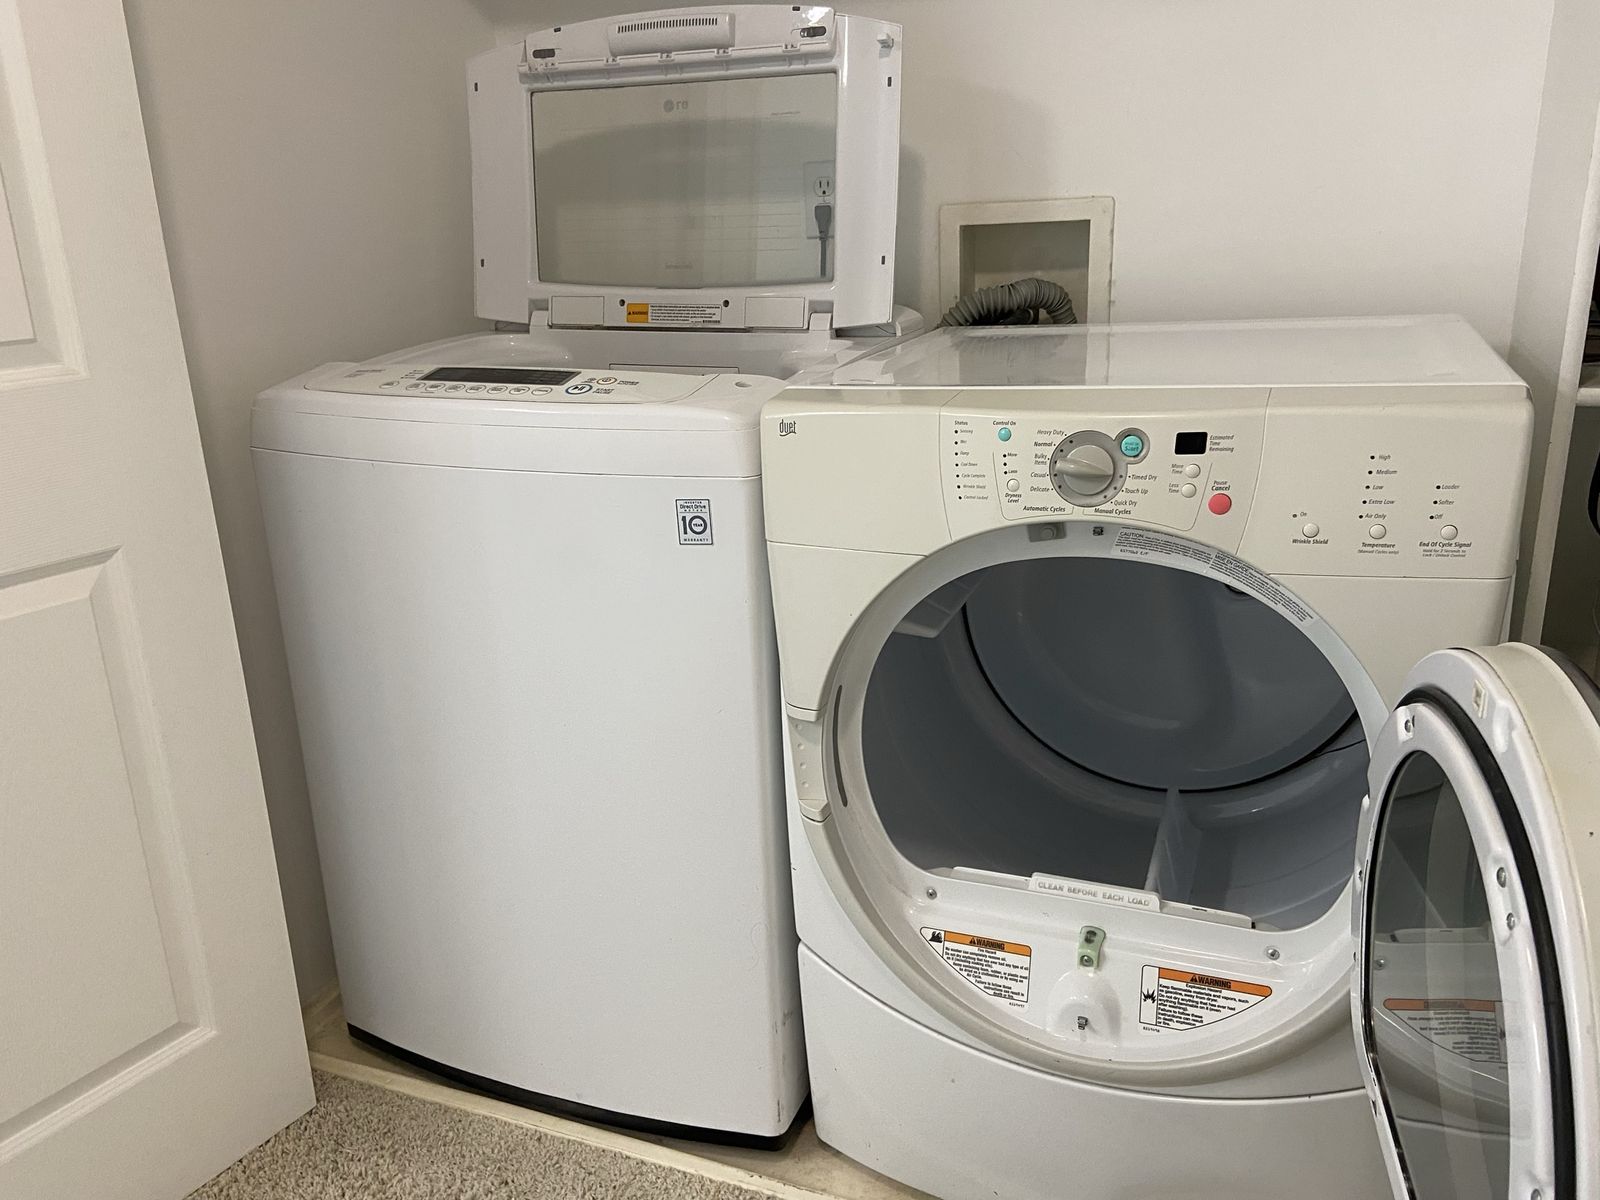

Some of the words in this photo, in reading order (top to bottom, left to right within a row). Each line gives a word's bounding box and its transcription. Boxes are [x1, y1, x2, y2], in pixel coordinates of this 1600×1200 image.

[779, 418, 796, 436] duet
[682, 515, 707, 535] 10
[1038, 882, 1064, 892] CLEAN
[1067, 886, 1098, 898] BEFORE
[1102, 892, 1124, 902] EACH
[1128, 896, 1150, 906] LOAD
[976, 938, 1004, 949] WARNING
[1198, 976, 1231, 988] WARNING
